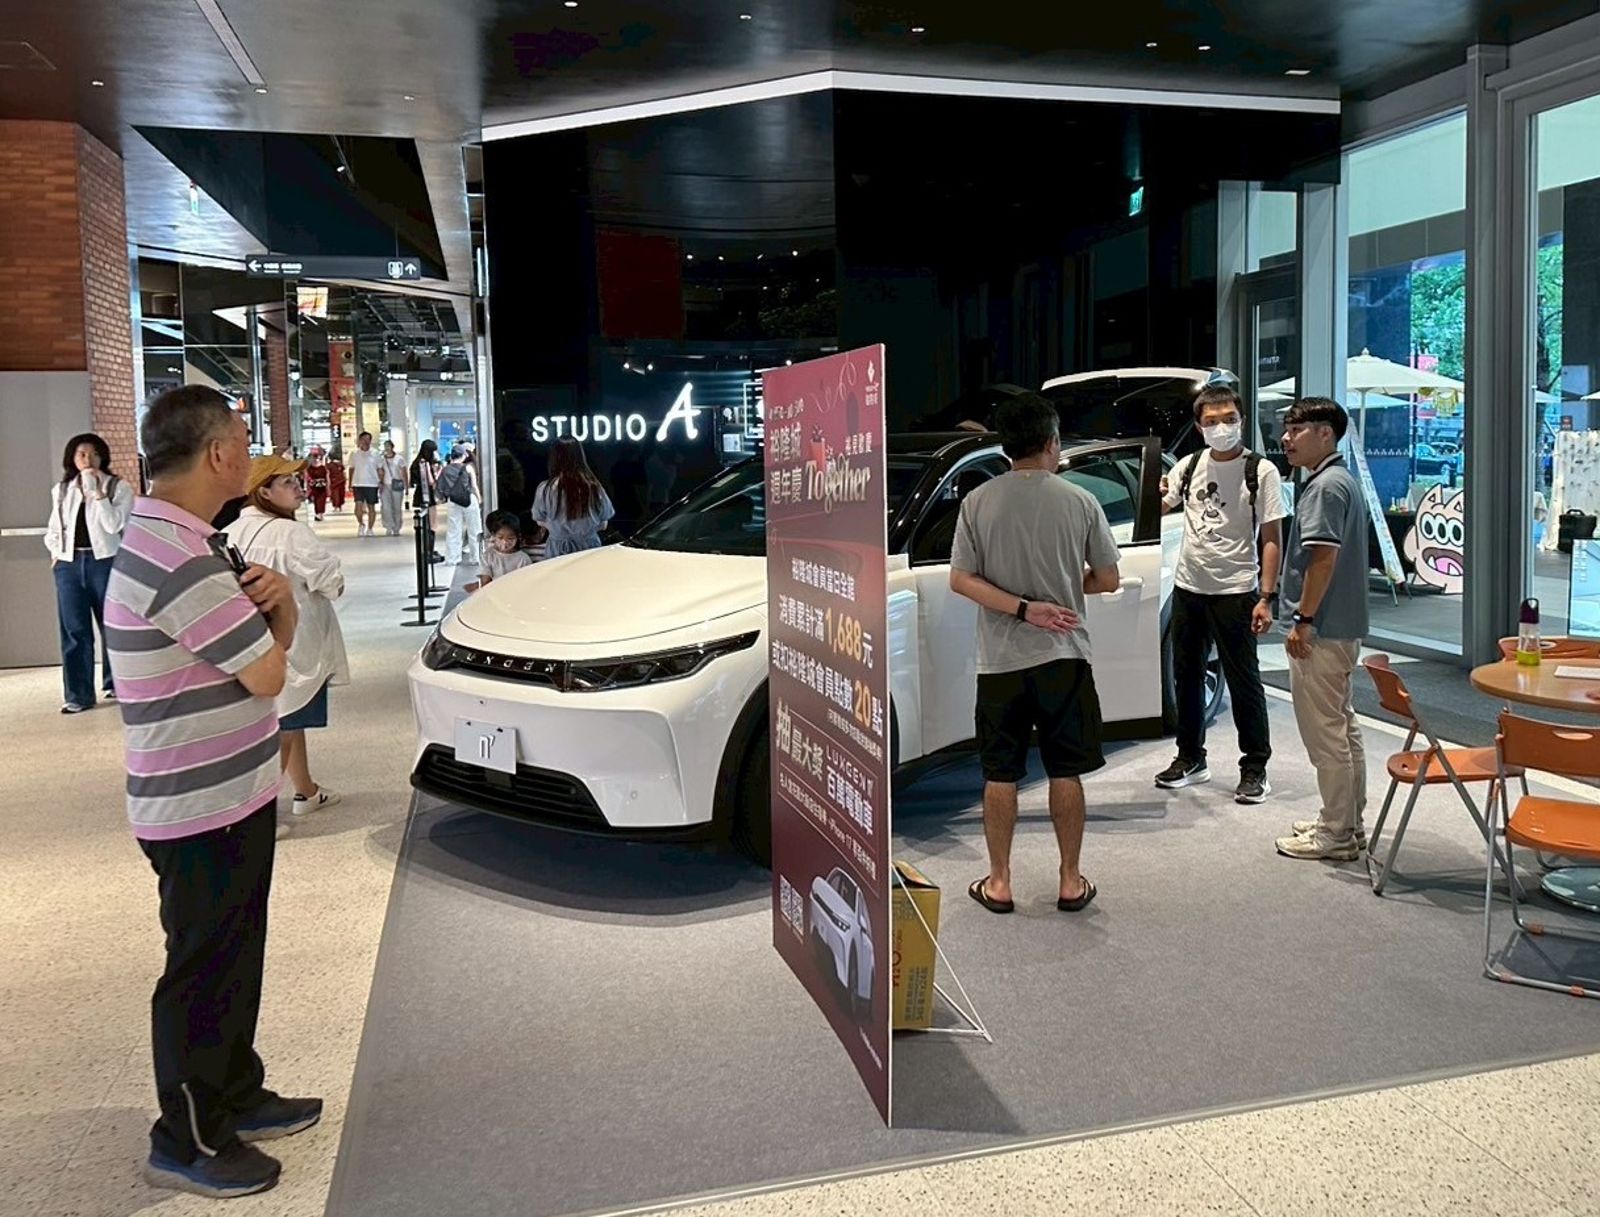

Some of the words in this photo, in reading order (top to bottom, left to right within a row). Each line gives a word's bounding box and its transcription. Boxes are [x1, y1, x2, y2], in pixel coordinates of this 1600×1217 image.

[531, 413, 647, 443] STUDIO
[656, 382, 702, 442] A
[770, 466, 802, 504] 週年慶
[805, 452, 872, 514] Together
[827, 765, 873, 834] 百萬電動車
